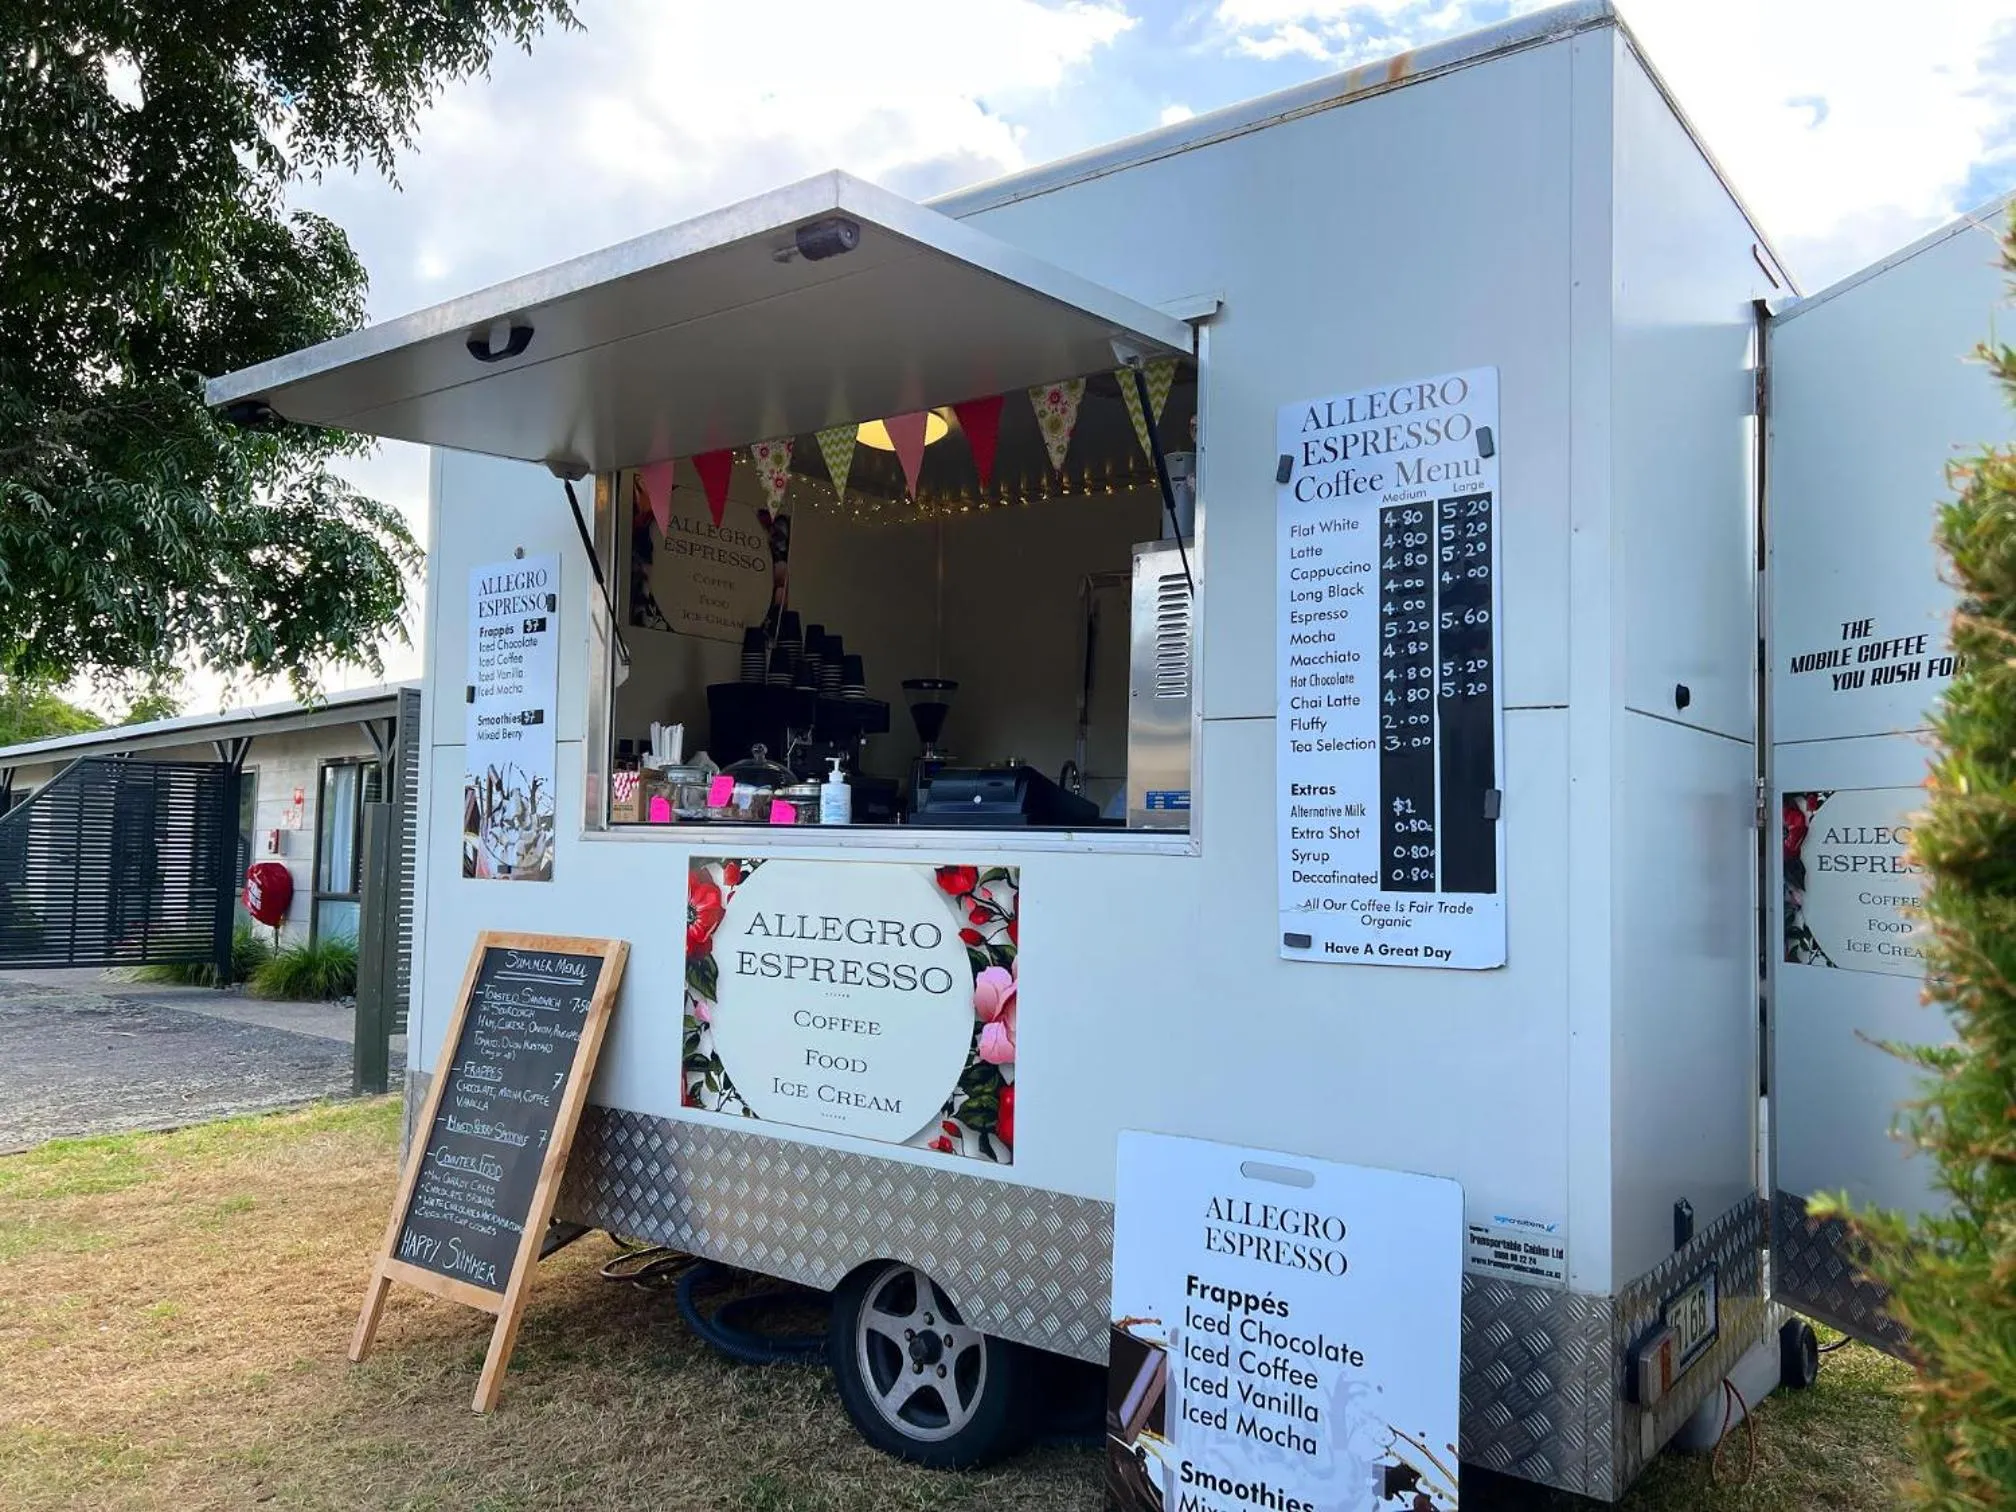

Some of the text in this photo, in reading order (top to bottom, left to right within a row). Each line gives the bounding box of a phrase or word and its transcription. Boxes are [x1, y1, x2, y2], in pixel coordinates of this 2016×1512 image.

[1302, 377, 1468, 433] ALLEGRO
[1303, 413, 1472, 467] ESPRESSO
[1295, 457, 1481, 503] Coffee Menu
[1382, 480, 1485, 503] Medium Large
[1442, 500, 1489, 519] 5.20
[668, 515, 762, 550] ALLEGRO
[1290, 518, 1360, 538] Flat White
[1382, 522, 1488, 549] 4.80 5.20
[664, 536, 766, 572] ESPRESSO
[1290, 546, 1323, 560] Latte
[1382, 542, 1487, 571] 4.80 5.20
[1290, 561, 1372, 581] Cappuccino
[1384, 566, 1489, 592] 4.00 4.00
[478, 567, 548, 596] ALLEGRO
[1290, 583, 1365, 604] Long Black
[479, 592, 548, 618] ESPRESSO
[1382, 600, 1426, 615] 4.00
[1290, 609, 1349, 625] Espresso
[1384, 608, 1490, 638] 5.20 5.60
[480, 624, 514, 639] Frappés
[1290, 630, 1336, 645] Mocha
[1841, 617, 1876, 640] THE
[480, 637, 538, 653] Iced Chocolate
[1382, 642, 1429, 658] 4.80
[1790, 633, 1929, 674] MOBILE COFFEE
[479, 652, 523, 668] Iced Coffee
[1290, 651, 1361, 667] Macchiato
[479, 668, 524, 682] Iced Vanilla
[1290, 672, 1355, 688] Hot Chocolate
[1383, 659, 1489, 682] 4.80 5.20
[1832, 669, 1865, 691] YOU
[1870, 661, 1921, 686] RUSH
[478, 683, 523, 697] Iced Mocha
[1384, 682, 1487, 707] 4.80 5.20
[1290, 694, 1361, 710] Chai Latte
[478, 713, 522, 726] Smoothies
[1290, 716, 1328, 733] Fluffy
[1382, 714, 1430, 729] 2.00
[477, 728, 523, 741] Mixed Berry
[1384, 735, 1432, 751] 3.00
[1290, 737, 1376, 753] Tea Selection
[1291, 783, 1336, 796] Extras
[1291, 804, 1366, 818] Alternative Milk
[1291, 826, 1361, 840] Extra Shot
[1822, 826, 1912, 845] ALLEG
[1291, 849, 1330, 865] Syrup
[1817, 855, 1920, 874] ESPRE
[1292, 870, 1378, 884] Deccafinated
[1304, 898, 1474, 915] All Our Coffee Is Fair Trade
[1858, 892, 1921, 908] COFFEE
[744, 911, 942, 949] ALLEGRO
[1360, 914, 1413, 929] Organic
[1868, 919, 1913, 933] FOOD
[1324, 941, 1453, 961] Have A Great Day
[1846, 939, 1873, 953] ICE
[736, 950, 953, 994] ESPRESSO
[793, 1009, 882, 1036] COFFEE
[805, 1049, 868, 1074] FOOD
[772, 1077, 902, 1114] ICE CREAM
[1205, 1196, 1347, 1243] ALLEGRO
[400, 1226, 497, 1286] HAPPY SUMMER
[1205, 1227, 1348, 1277] ESPRESSO
[1187, 1274, 1290, 1318] Frappés
[1185, 1306, 1364, 1368] Iced Chocolate
[1184, 1336, 1319, 1390] Iced Coffee
[1183, 1368, 1320, 1423] Iced Vanilla
[1182, 1398, 1318, 1456] Iced Mocha
